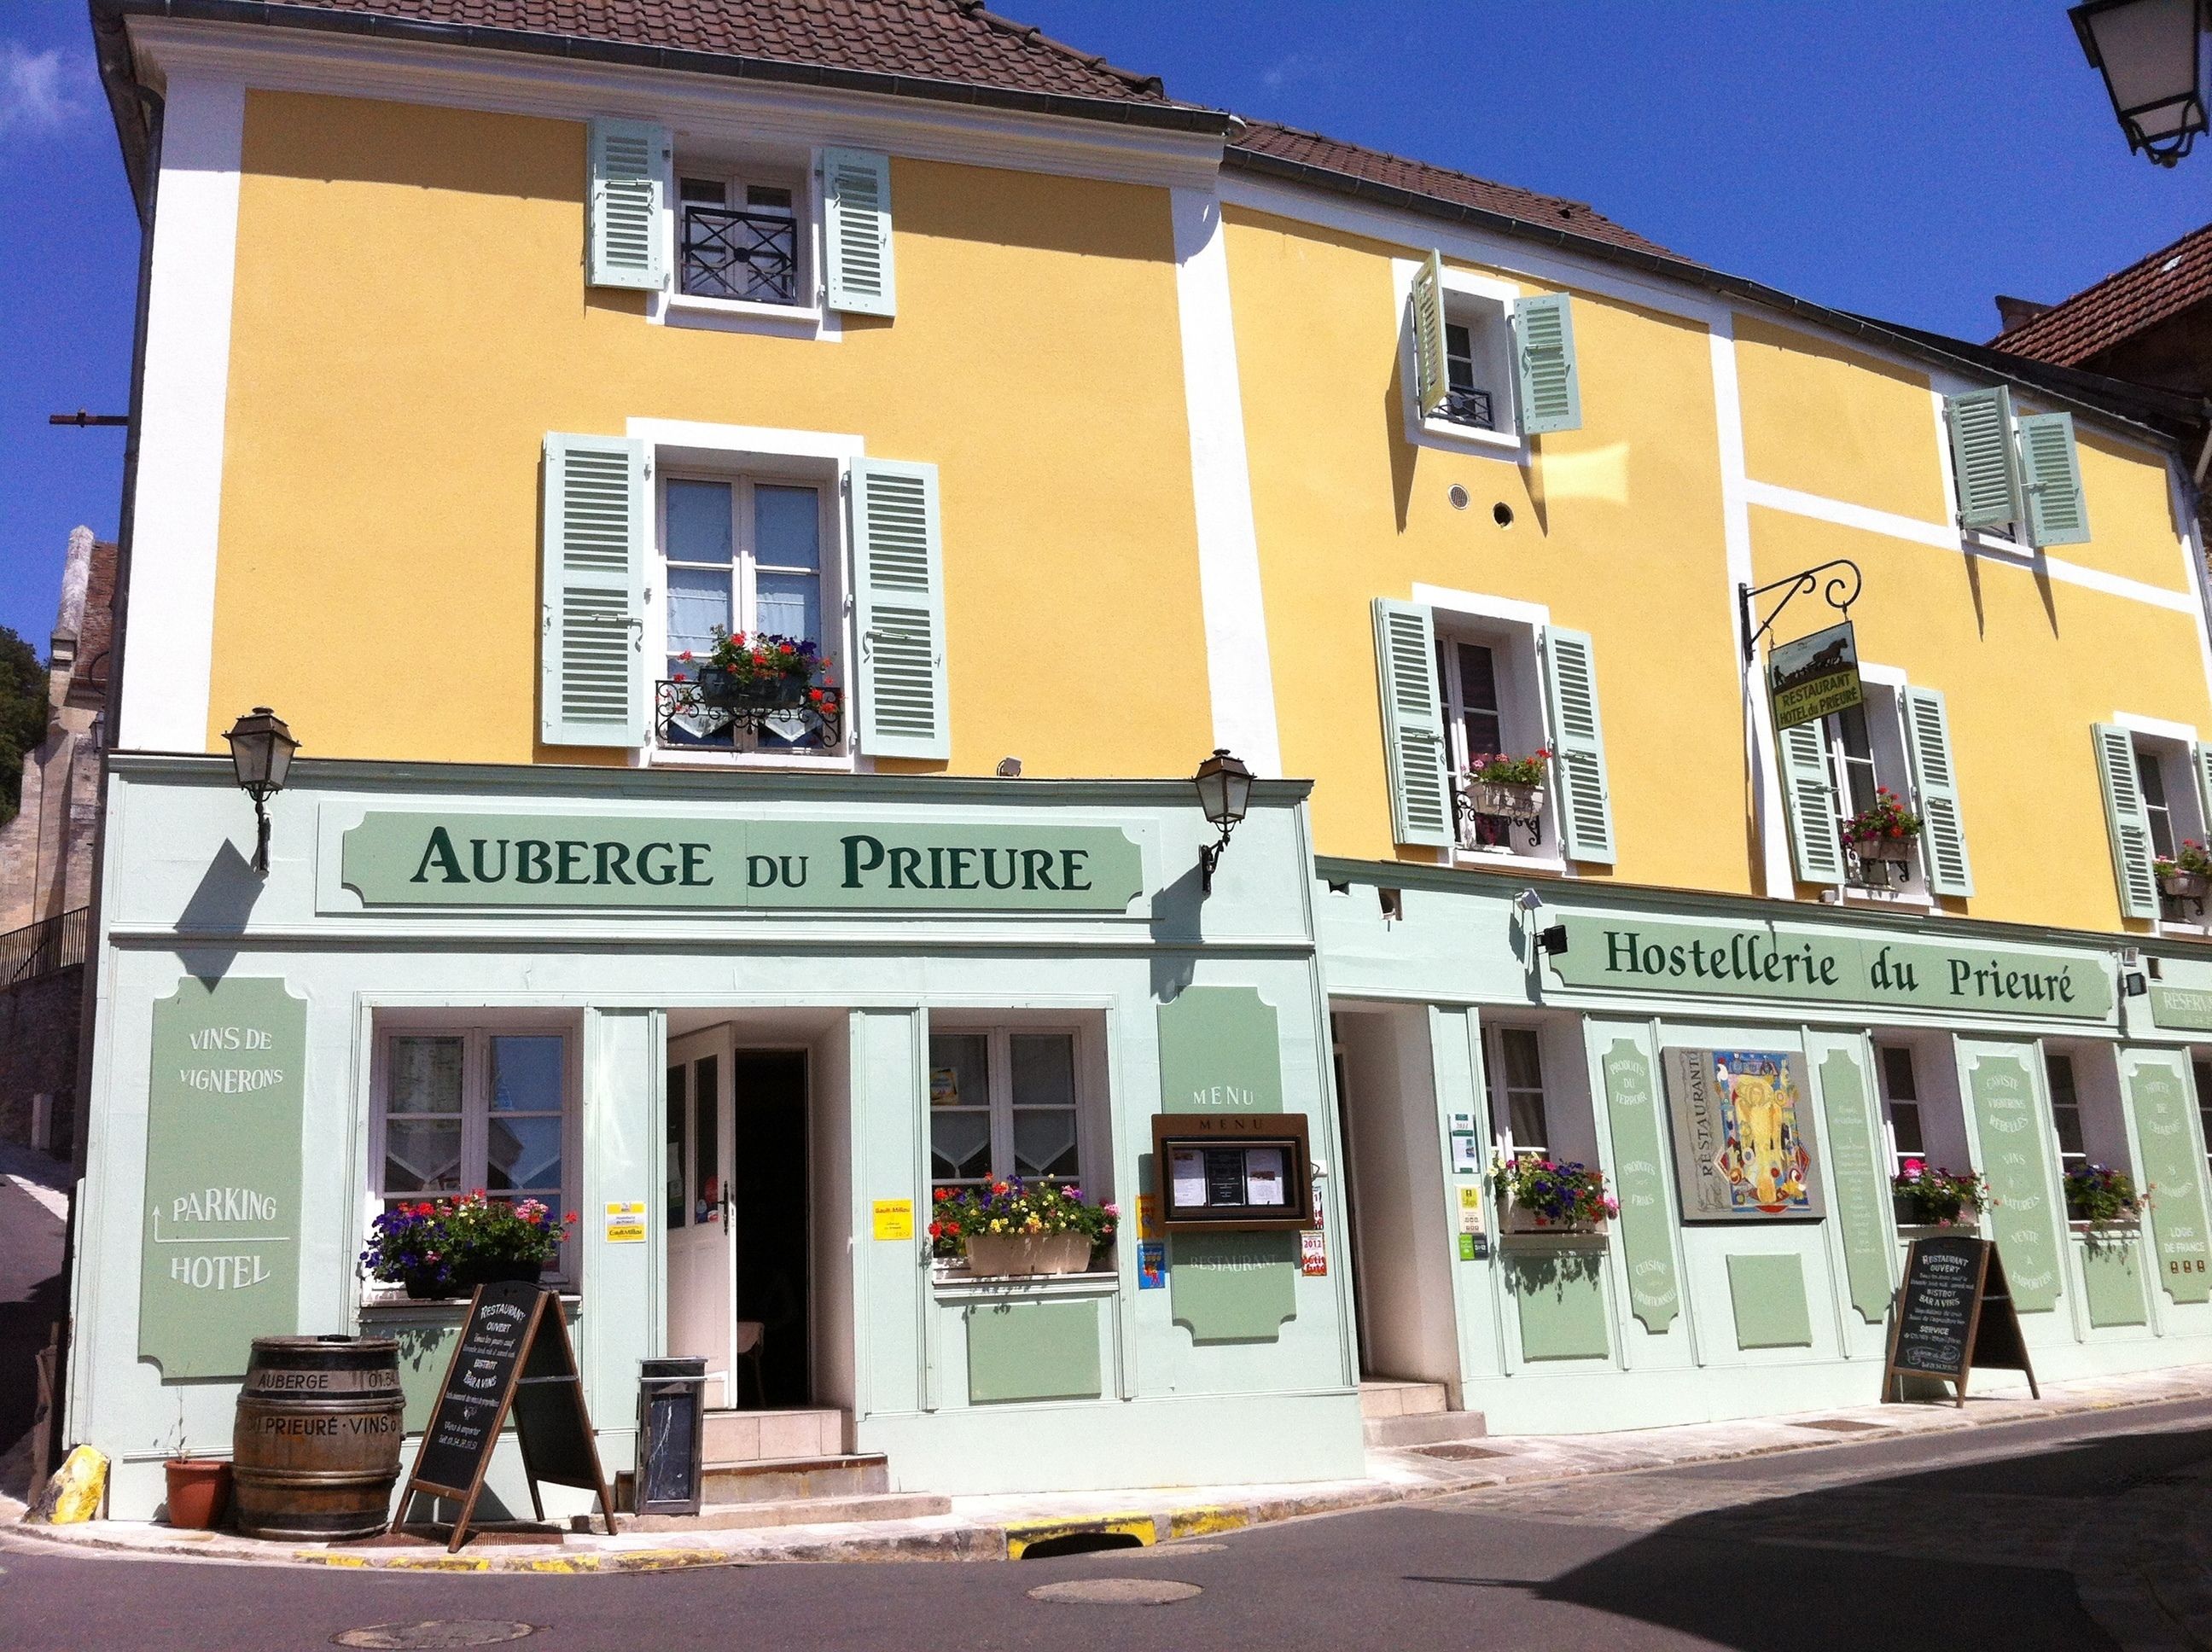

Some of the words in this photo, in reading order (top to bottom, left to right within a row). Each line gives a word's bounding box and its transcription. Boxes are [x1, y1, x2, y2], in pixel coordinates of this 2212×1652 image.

[1782, 674, 1850, 707] RESTAURANT
[1780, 707, 1808, 724] HOTEL
[1809, 703, 1819, 714] du
[410, 826, 713, 886] AUBERGE
[747, 855, 808, 887] DU
[841, 835, 1092, 891] PRIEURE
[1604, 931, 1839, 986] Hostellerie
[1871, 946, 1919, 991] du
[1947, 958, 2075, 1003] Prieuré
[189, 1027, 240, 1050] VINS
[245, 1027, 272, 1050] DE
[1610, 1060, 1646, 1076] PRODUITS
[180, 1068, 283, 1094] VIGNERONS
[1624, 1079, 1635, 1088] DU
[1194, 1085, 1254, 1105] MENU
[1615, 1091, 1648, 1106] TERROIR
[1201, 1119, 1263, 1130] MENU
[1691, 1059, 1713, 1177] RESTAURANT
[173, 1188, 276, 1221] PARKING
[1632, 1194, 1654, 1207] FRAIS
[1190, 1254, 1277, 1272] RESTAURANT
[1636, 1259, 1666, 1275] CUISINE
[1922, 1254, 1969, 1266] RESTAURANT
[1930, 1265, 1960, 1273] OUVERT
[171, 1256, 271, 1289] HOTEL
[1918, 1294, 1934, 1306] BAR
[480, 1304, 527, 1322] RESTAURANT
[1920, 1325, 1949, 1335] SERVICE
[258, 1373, 329, 1389] AUBERGE
[265, 1416, 338, 1435] PRIEURÉ
[349, 1416, 388, 1434] VINS
